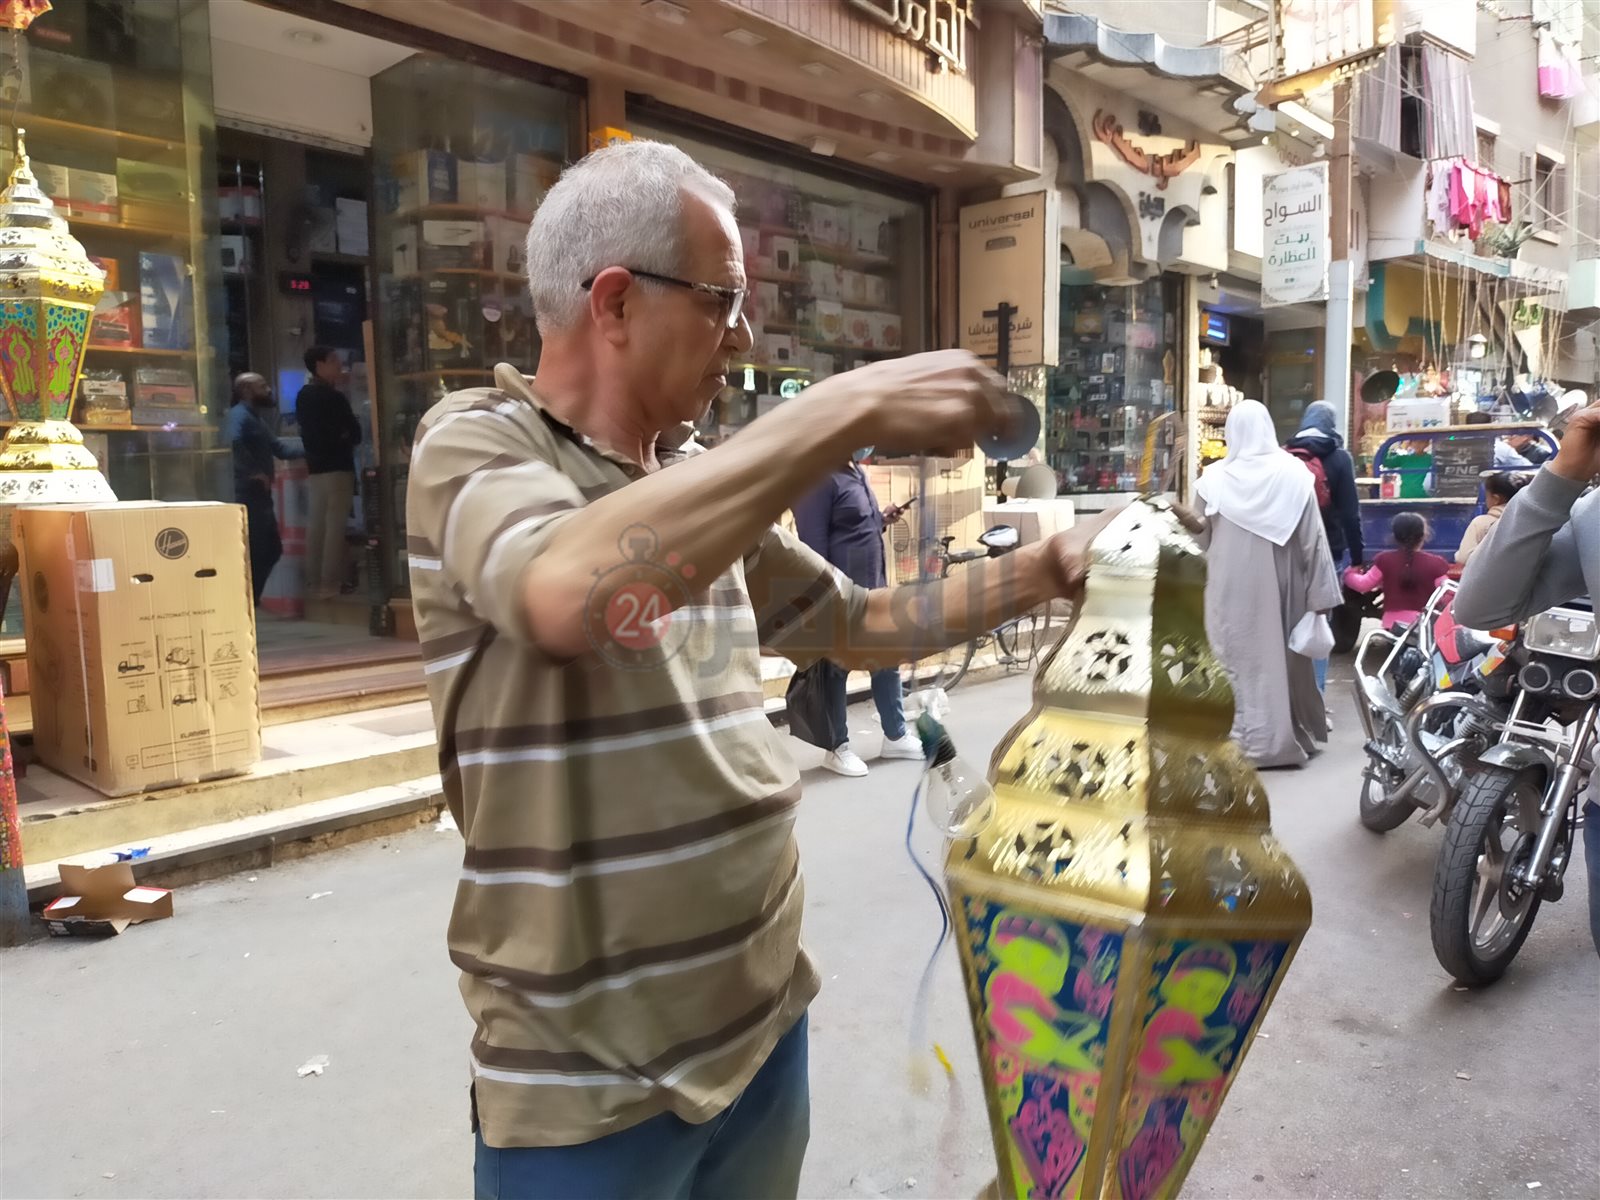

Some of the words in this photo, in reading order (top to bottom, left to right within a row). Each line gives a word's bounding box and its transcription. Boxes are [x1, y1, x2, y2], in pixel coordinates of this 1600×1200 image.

[968, 208, 1034, 229] universal
[1264, 194, 1322, 227] السواح
[1268, 246, 1316, 266] العطارة
[1008, 317, 1033, 333] شرك
